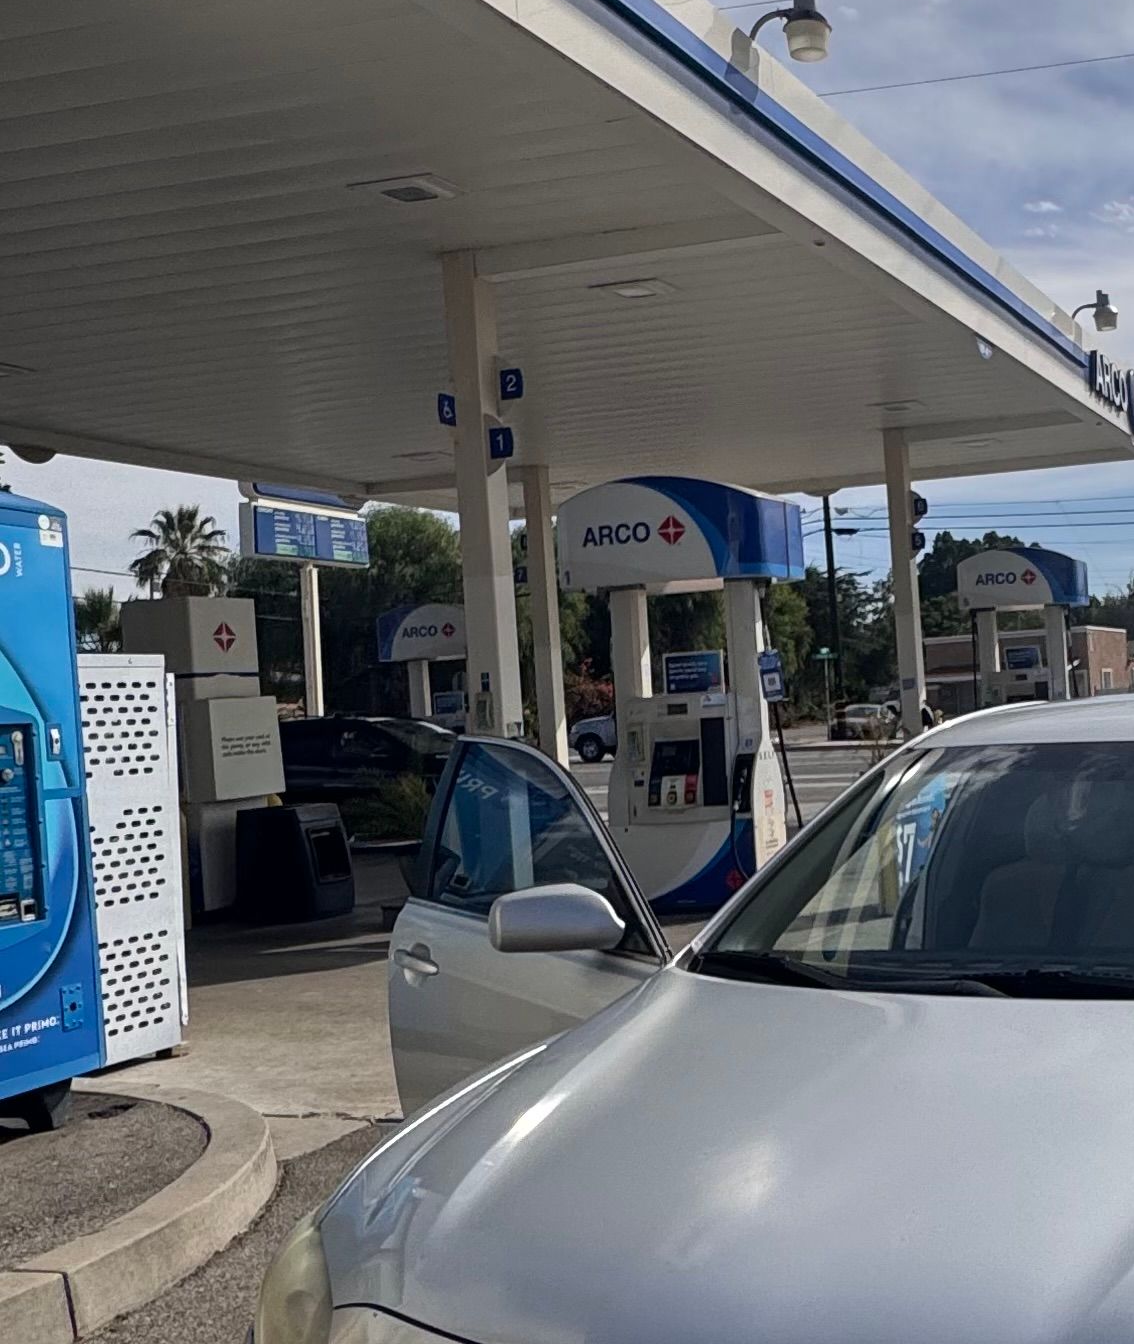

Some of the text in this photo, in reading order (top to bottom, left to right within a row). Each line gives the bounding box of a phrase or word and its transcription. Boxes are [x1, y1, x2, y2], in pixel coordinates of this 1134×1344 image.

[505, 374, 517, 392] 2
[1090, 350, 1128, 412] ARCO
[496, 433, 504, 452] 1
[582, 521, 651, 548] ARCO
[13, 542, 23, 577] WATER
[564, 570, 571, 586] 1
[975, 571, 1017, 586] ARCO
[402, 625, 438, 638] ARCO
[12, 1025, 21, 1037] IT
